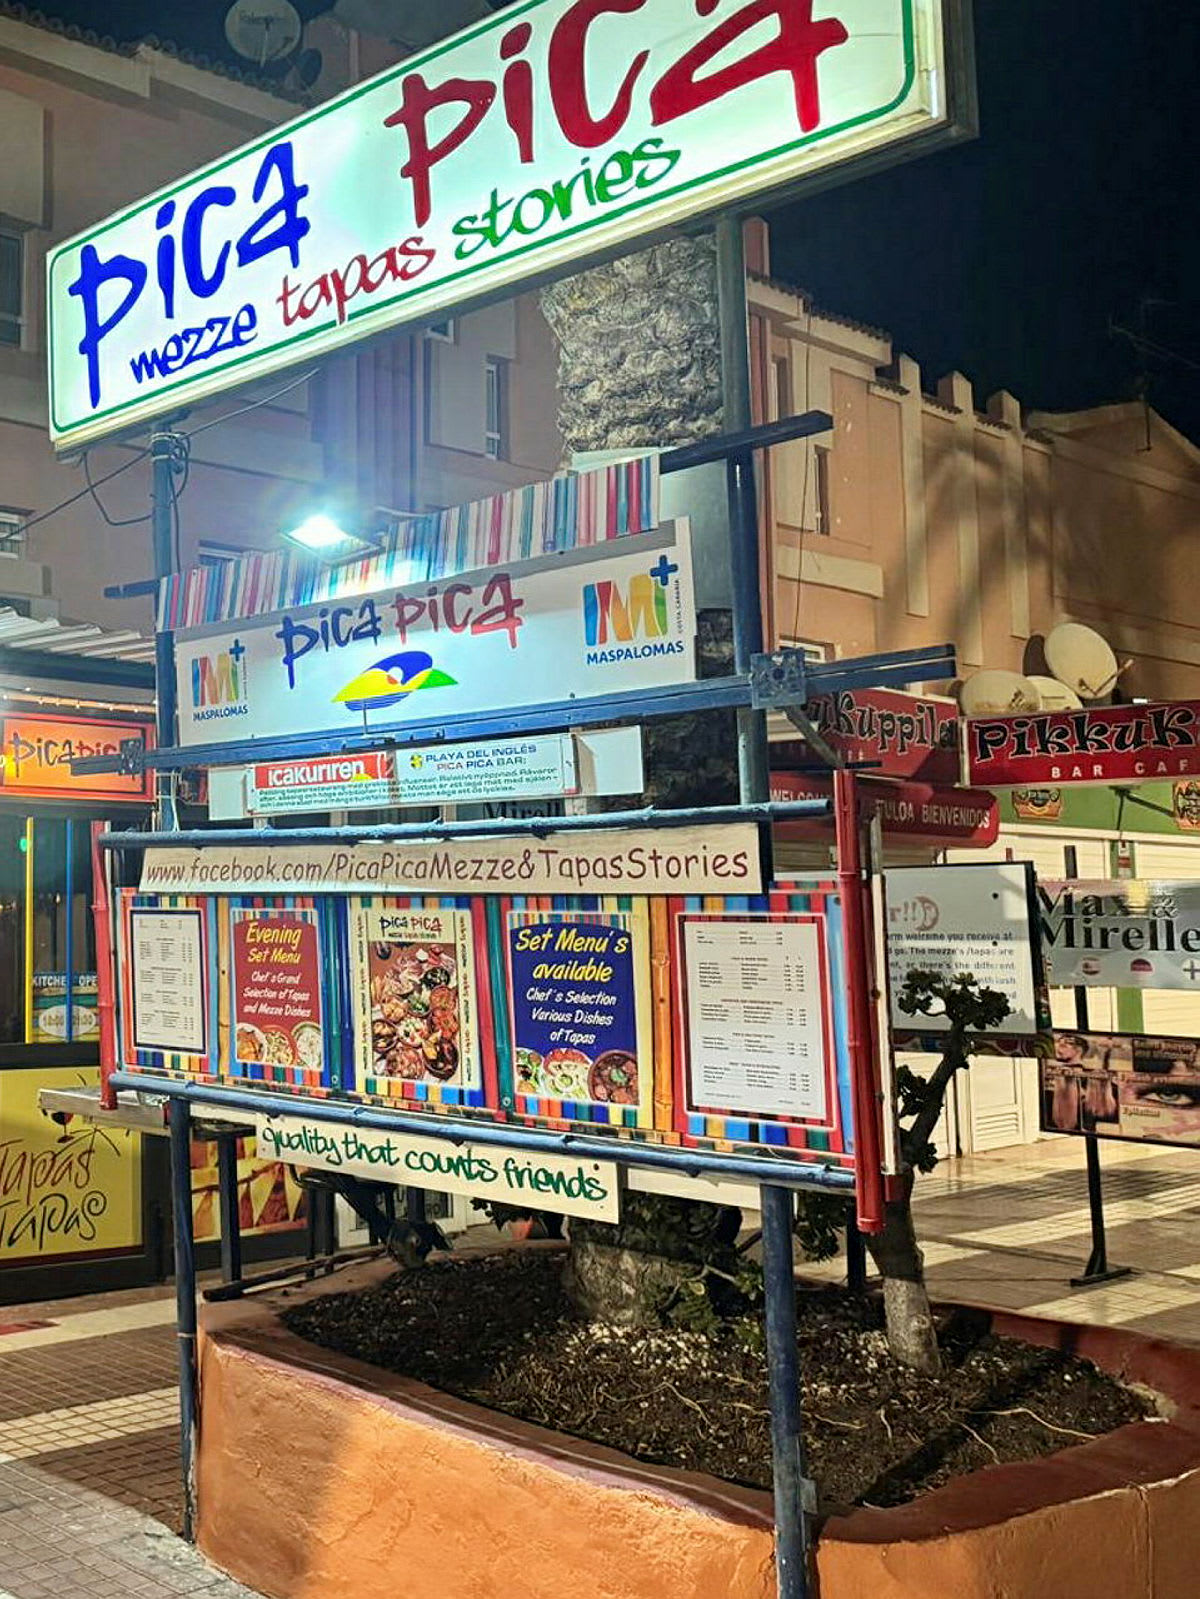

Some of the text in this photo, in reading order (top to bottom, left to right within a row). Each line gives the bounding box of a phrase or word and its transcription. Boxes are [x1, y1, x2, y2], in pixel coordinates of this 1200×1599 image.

[129, 138, 681, 385] mezze tapas stories
[586, 640, 684, 665] MASPALOMAS
[192, 704, 248, 721] MASPALOMAS
[425, 750, 464, 763] PLAYA
[467, 748, 490, 758] DEL
[436, 762, 464, 771] PICA
[466, 759, 494, 769] PICA
[1051, 764, 1103, 779] BAR
[922, 804, 990, 828] BIENVENIDOS
[246, 921, 302, 950] Evening
[516, 928, 553, 951] Set
[248, 949, 301, 964] Set Menu
[532, 957, 614, 983] available
[33, 975, 73, 987] KITCHE
[565, 990, 617, 1006] Selection
[532, 1008, 614, 1025] Various Dishes
[550, 1029, 596, 1045] of Tapas
[342, 1132, 400, 1167] that
[405, 1147, 498, 1183] counts
[502, 1159, 608, 1201] friends
